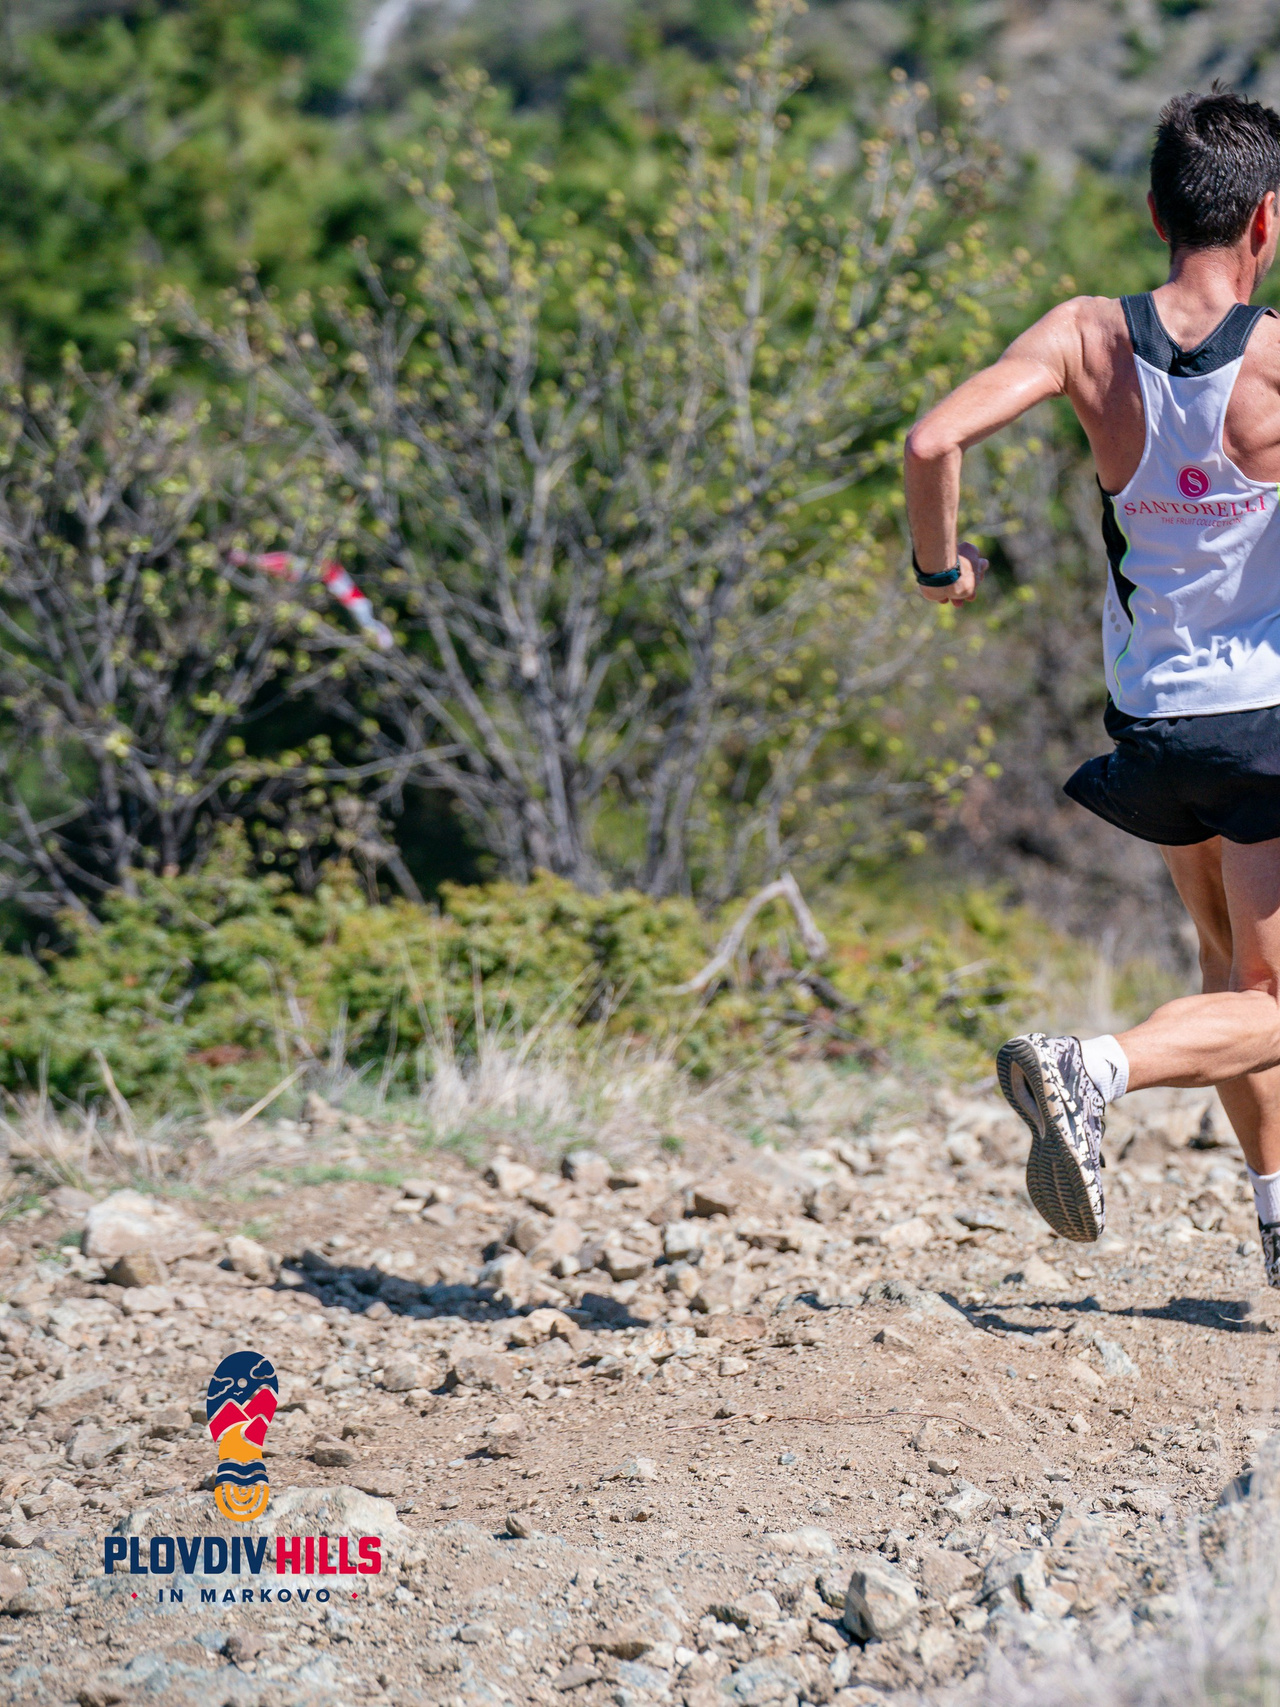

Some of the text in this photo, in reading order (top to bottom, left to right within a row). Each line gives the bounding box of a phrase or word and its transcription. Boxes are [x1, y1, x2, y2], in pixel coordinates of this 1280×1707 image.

[1124, 495, 1268, 518] SANTORELLI
[1161, 516, 1243, 528] THE FRUIT COLLECTION
